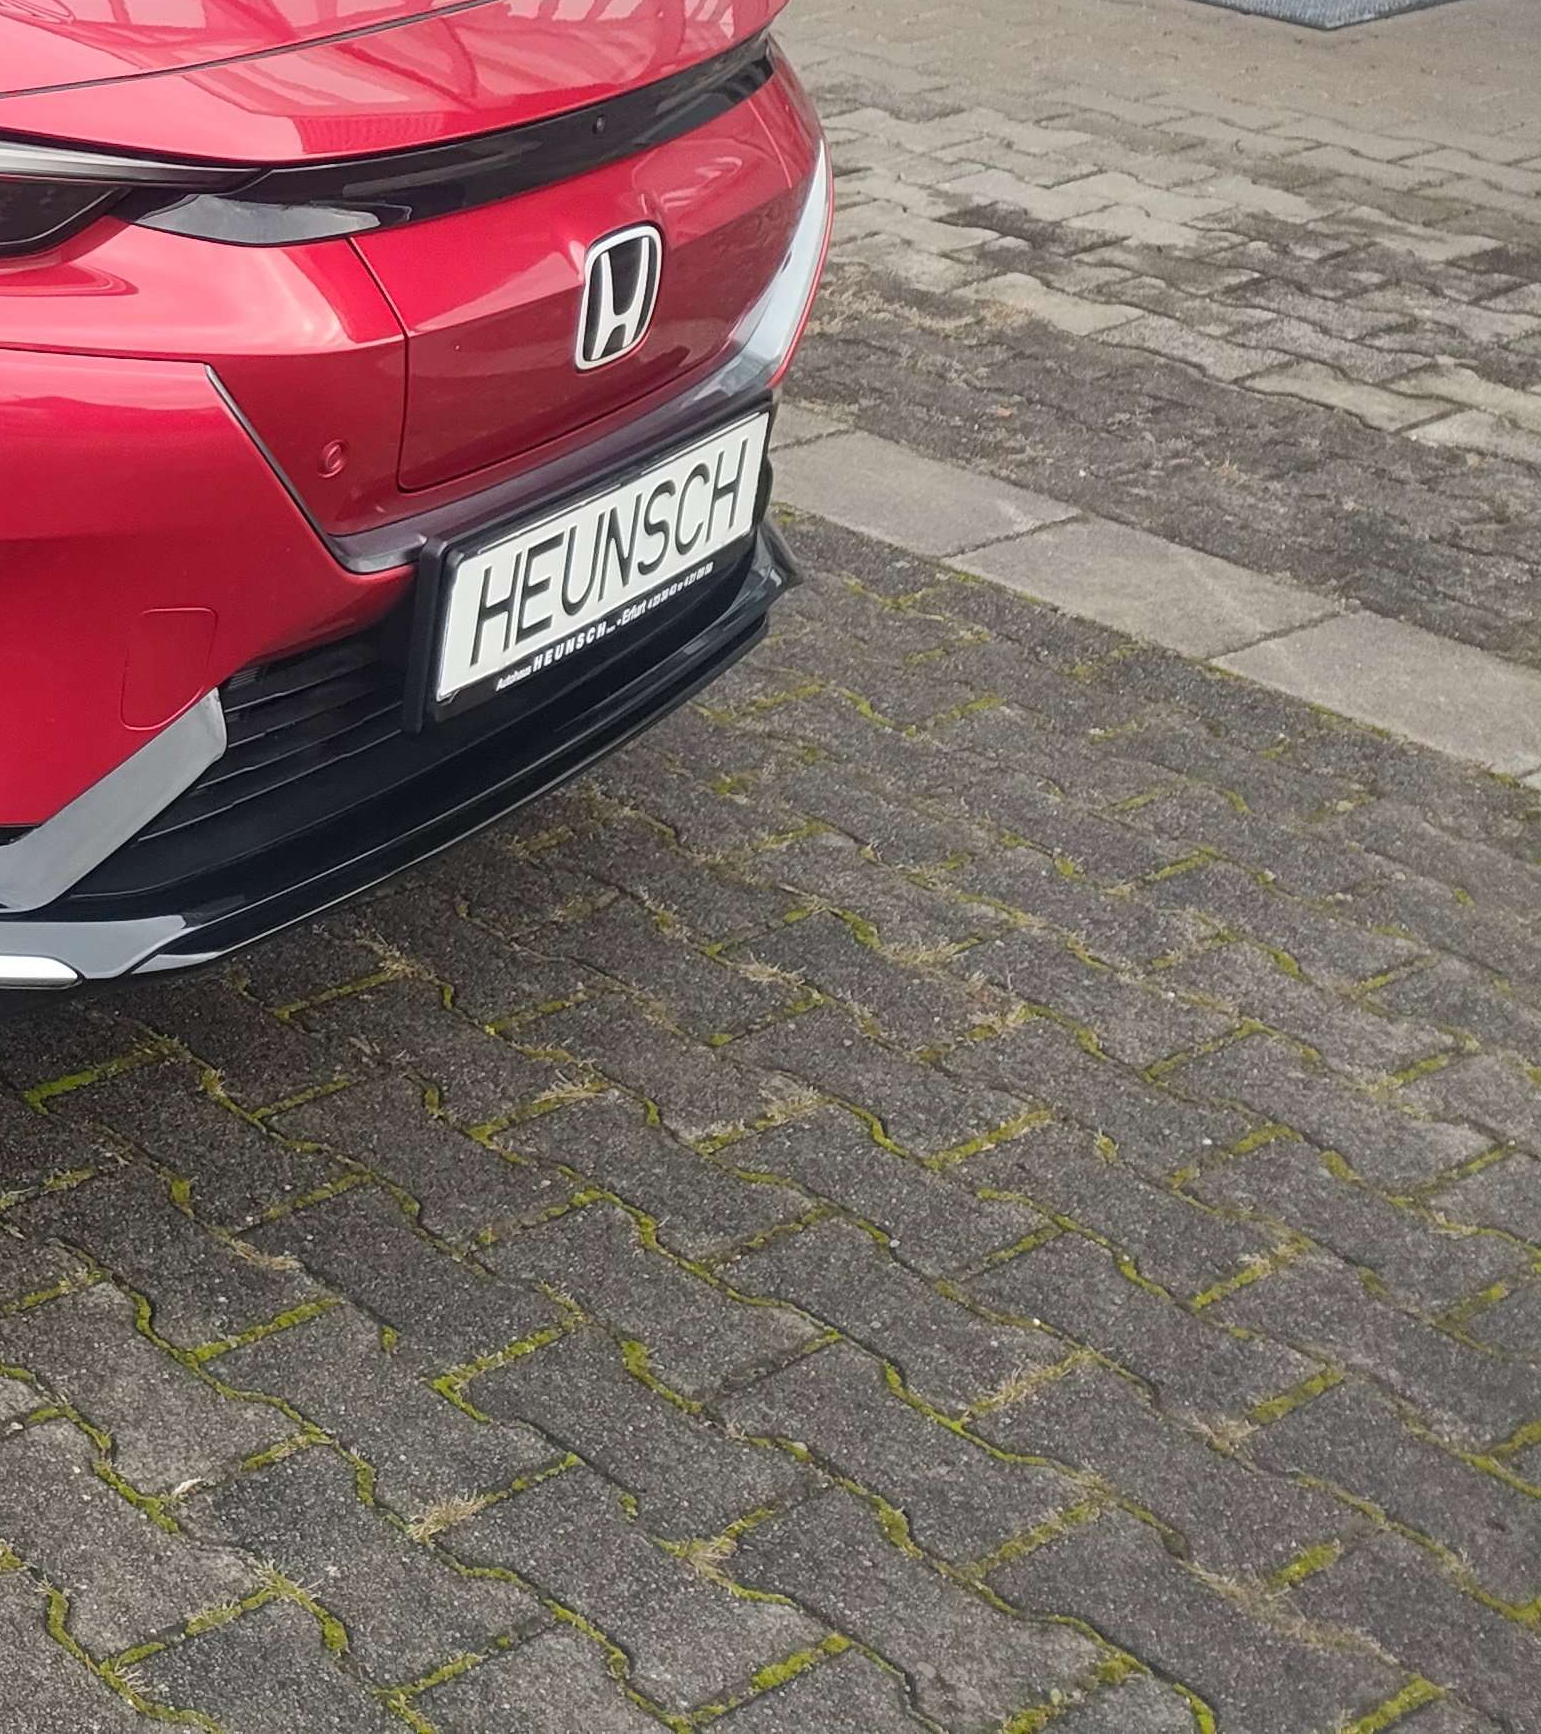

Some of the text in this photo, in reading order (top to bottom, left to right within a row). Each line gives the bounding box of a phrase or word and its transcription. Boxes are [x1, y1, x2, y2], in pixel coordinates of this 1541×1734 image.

[469, 437, 748, 668] HEUNSCH
[532, 620, 608, 673] HEUNSCH
[621, 599, 647, 627] Erfurt
